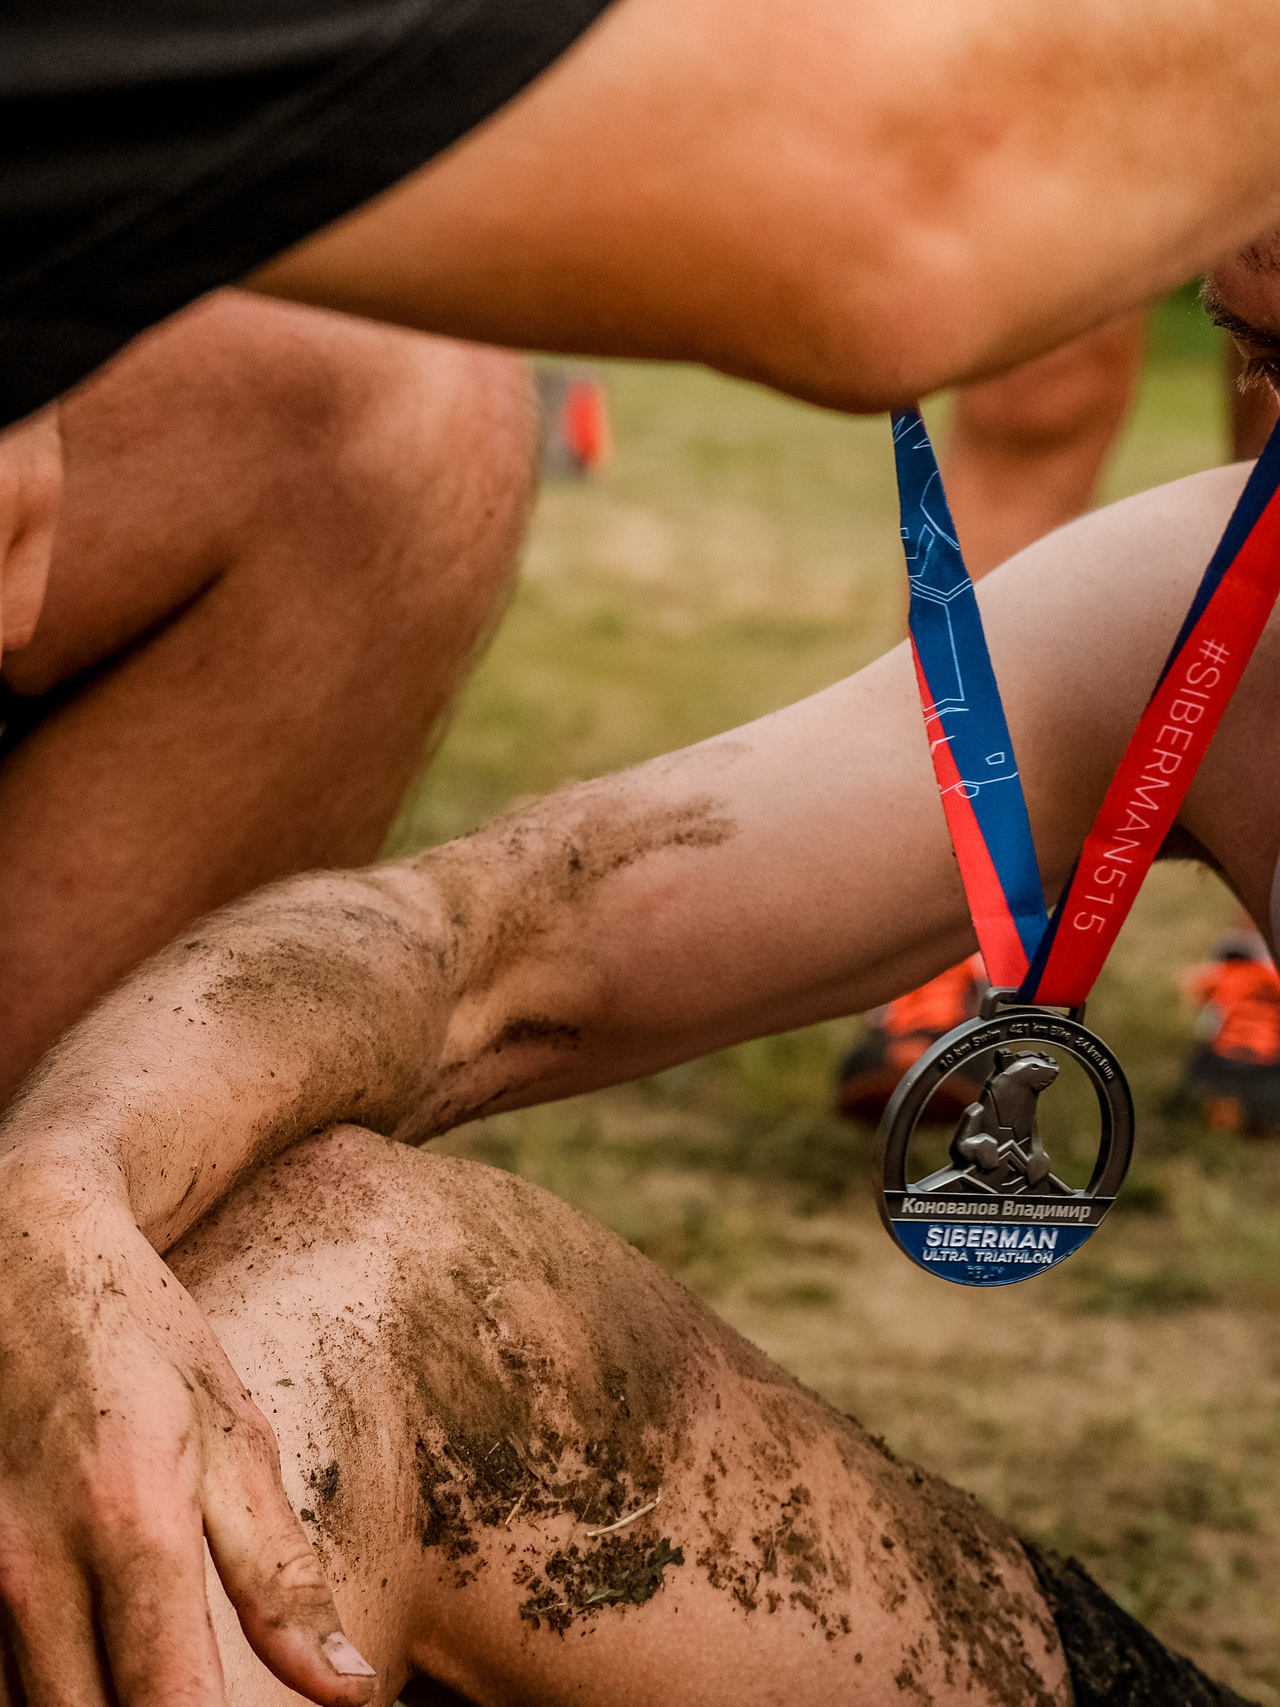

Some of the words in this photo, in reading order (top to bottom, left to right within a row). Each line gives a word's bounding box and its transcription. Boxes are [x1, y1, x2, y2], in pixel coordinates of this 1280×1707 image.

[1072, 638, 1230, 933] #SIBERMAN515
[939, 1053, 954, 1068] 10
[901, 1196, 1000, 1217] Коновалов
[1001, 1199, 1092, 1222] Владимир
[925, 1226, 1059, 1250] SIBERMAN
[922, 1249, 969, 1263] ULTRA
[974, 1250, 1055, 1265] TRIATHLON
